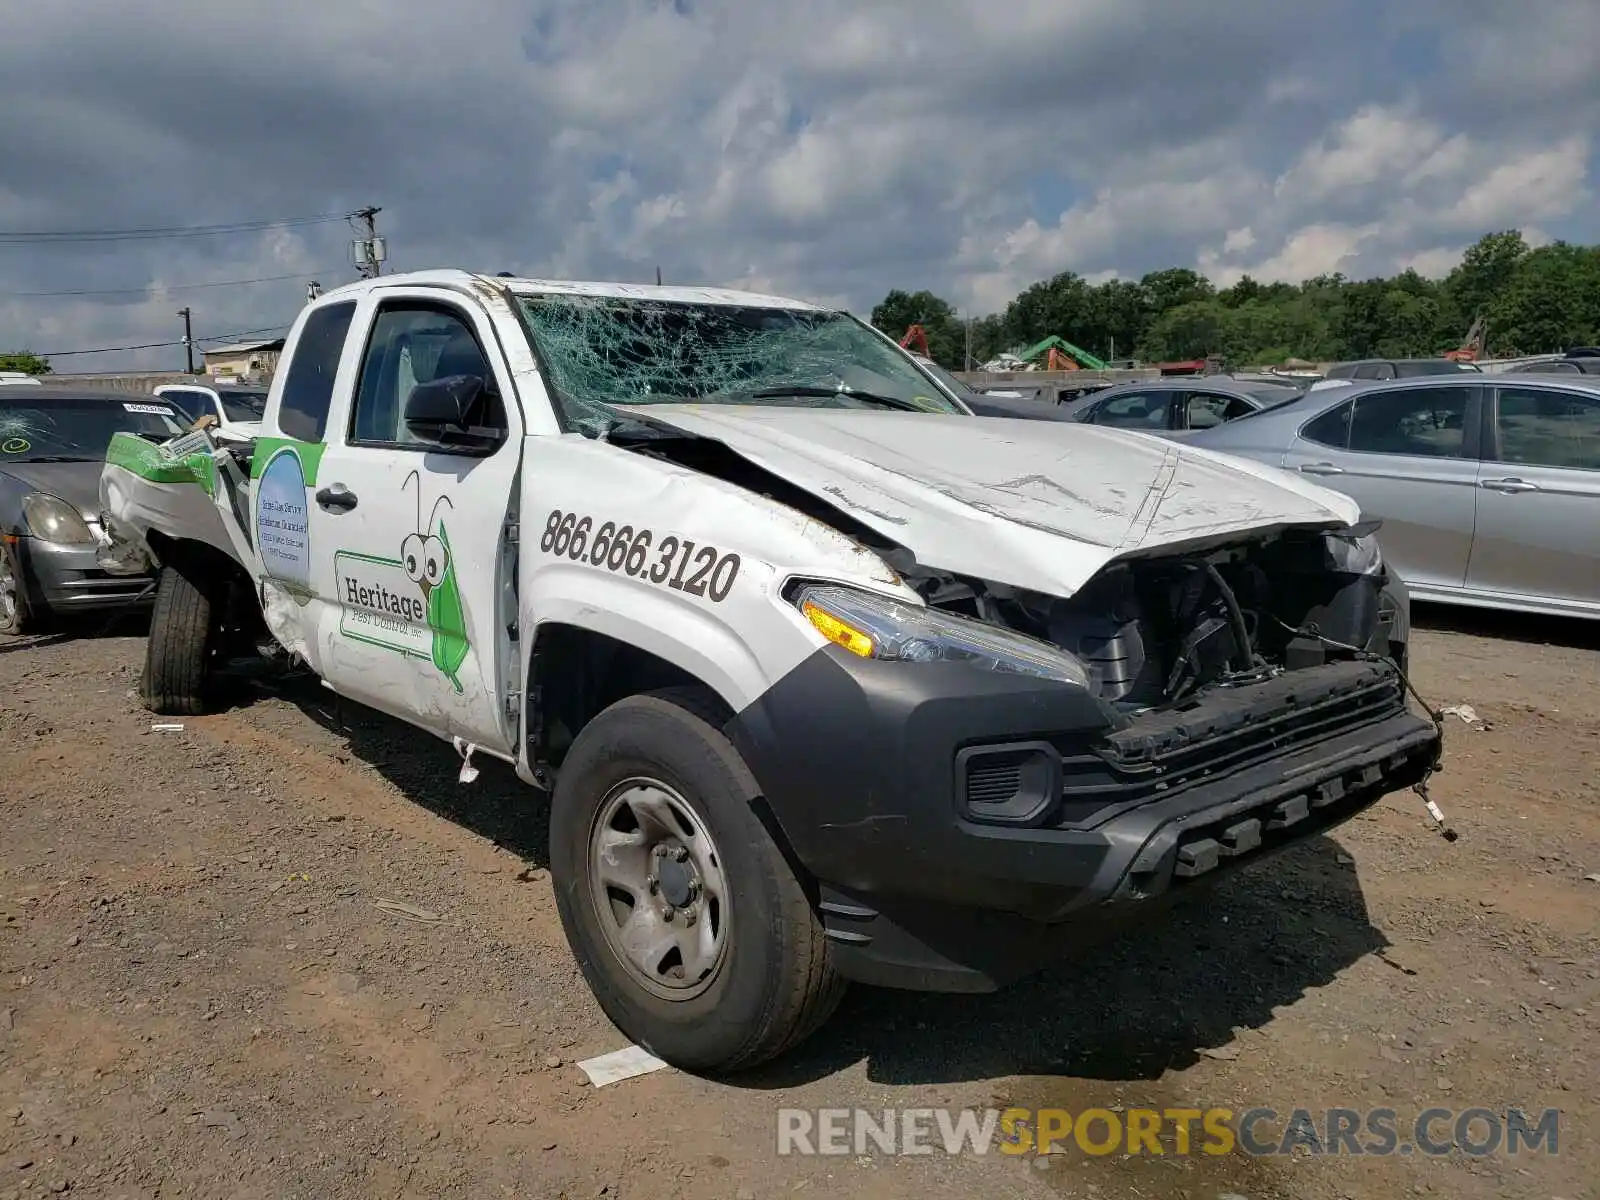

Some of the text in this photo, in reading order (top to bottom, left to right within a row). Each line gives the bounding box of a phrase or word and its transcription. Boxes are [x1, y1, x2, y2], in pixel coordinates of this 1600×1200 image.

[540, 509, 741, 603] 866.666.3120
[345, 577, 423, 622] Heritage
[352, 607, 372, 625] Pest
[374, 612, 408, 635] Control
